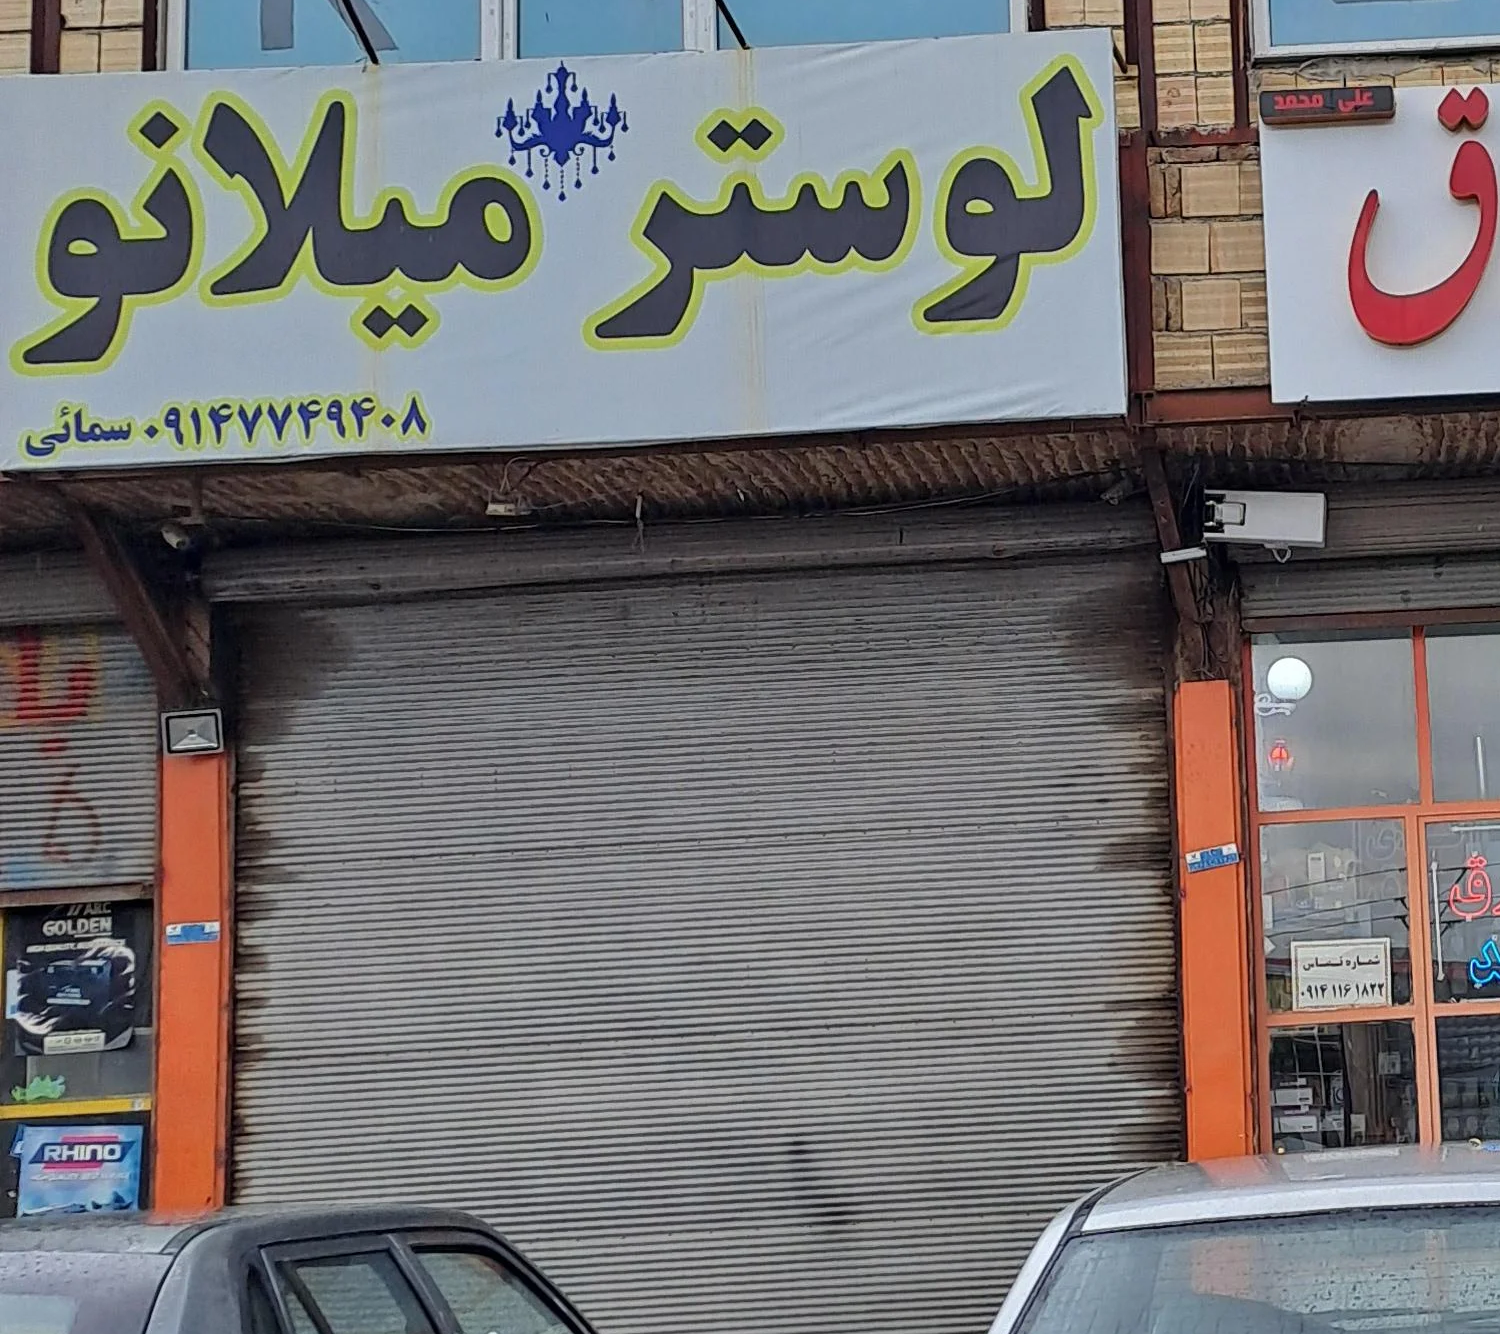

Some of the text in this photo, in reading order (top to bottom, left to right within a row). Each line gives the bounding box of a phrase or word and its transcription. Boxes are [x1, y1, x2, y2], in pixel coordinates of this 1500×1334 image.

[1272, 85, 1375, 113] علی محمد
[19, 61, 1098, 367] لوستر میلانو
[42, 916, 113, 936] GOLDEN
[1302, 954, 1380, 971] شماره تماس
[43, 1144, 122, 1162] RHINO
